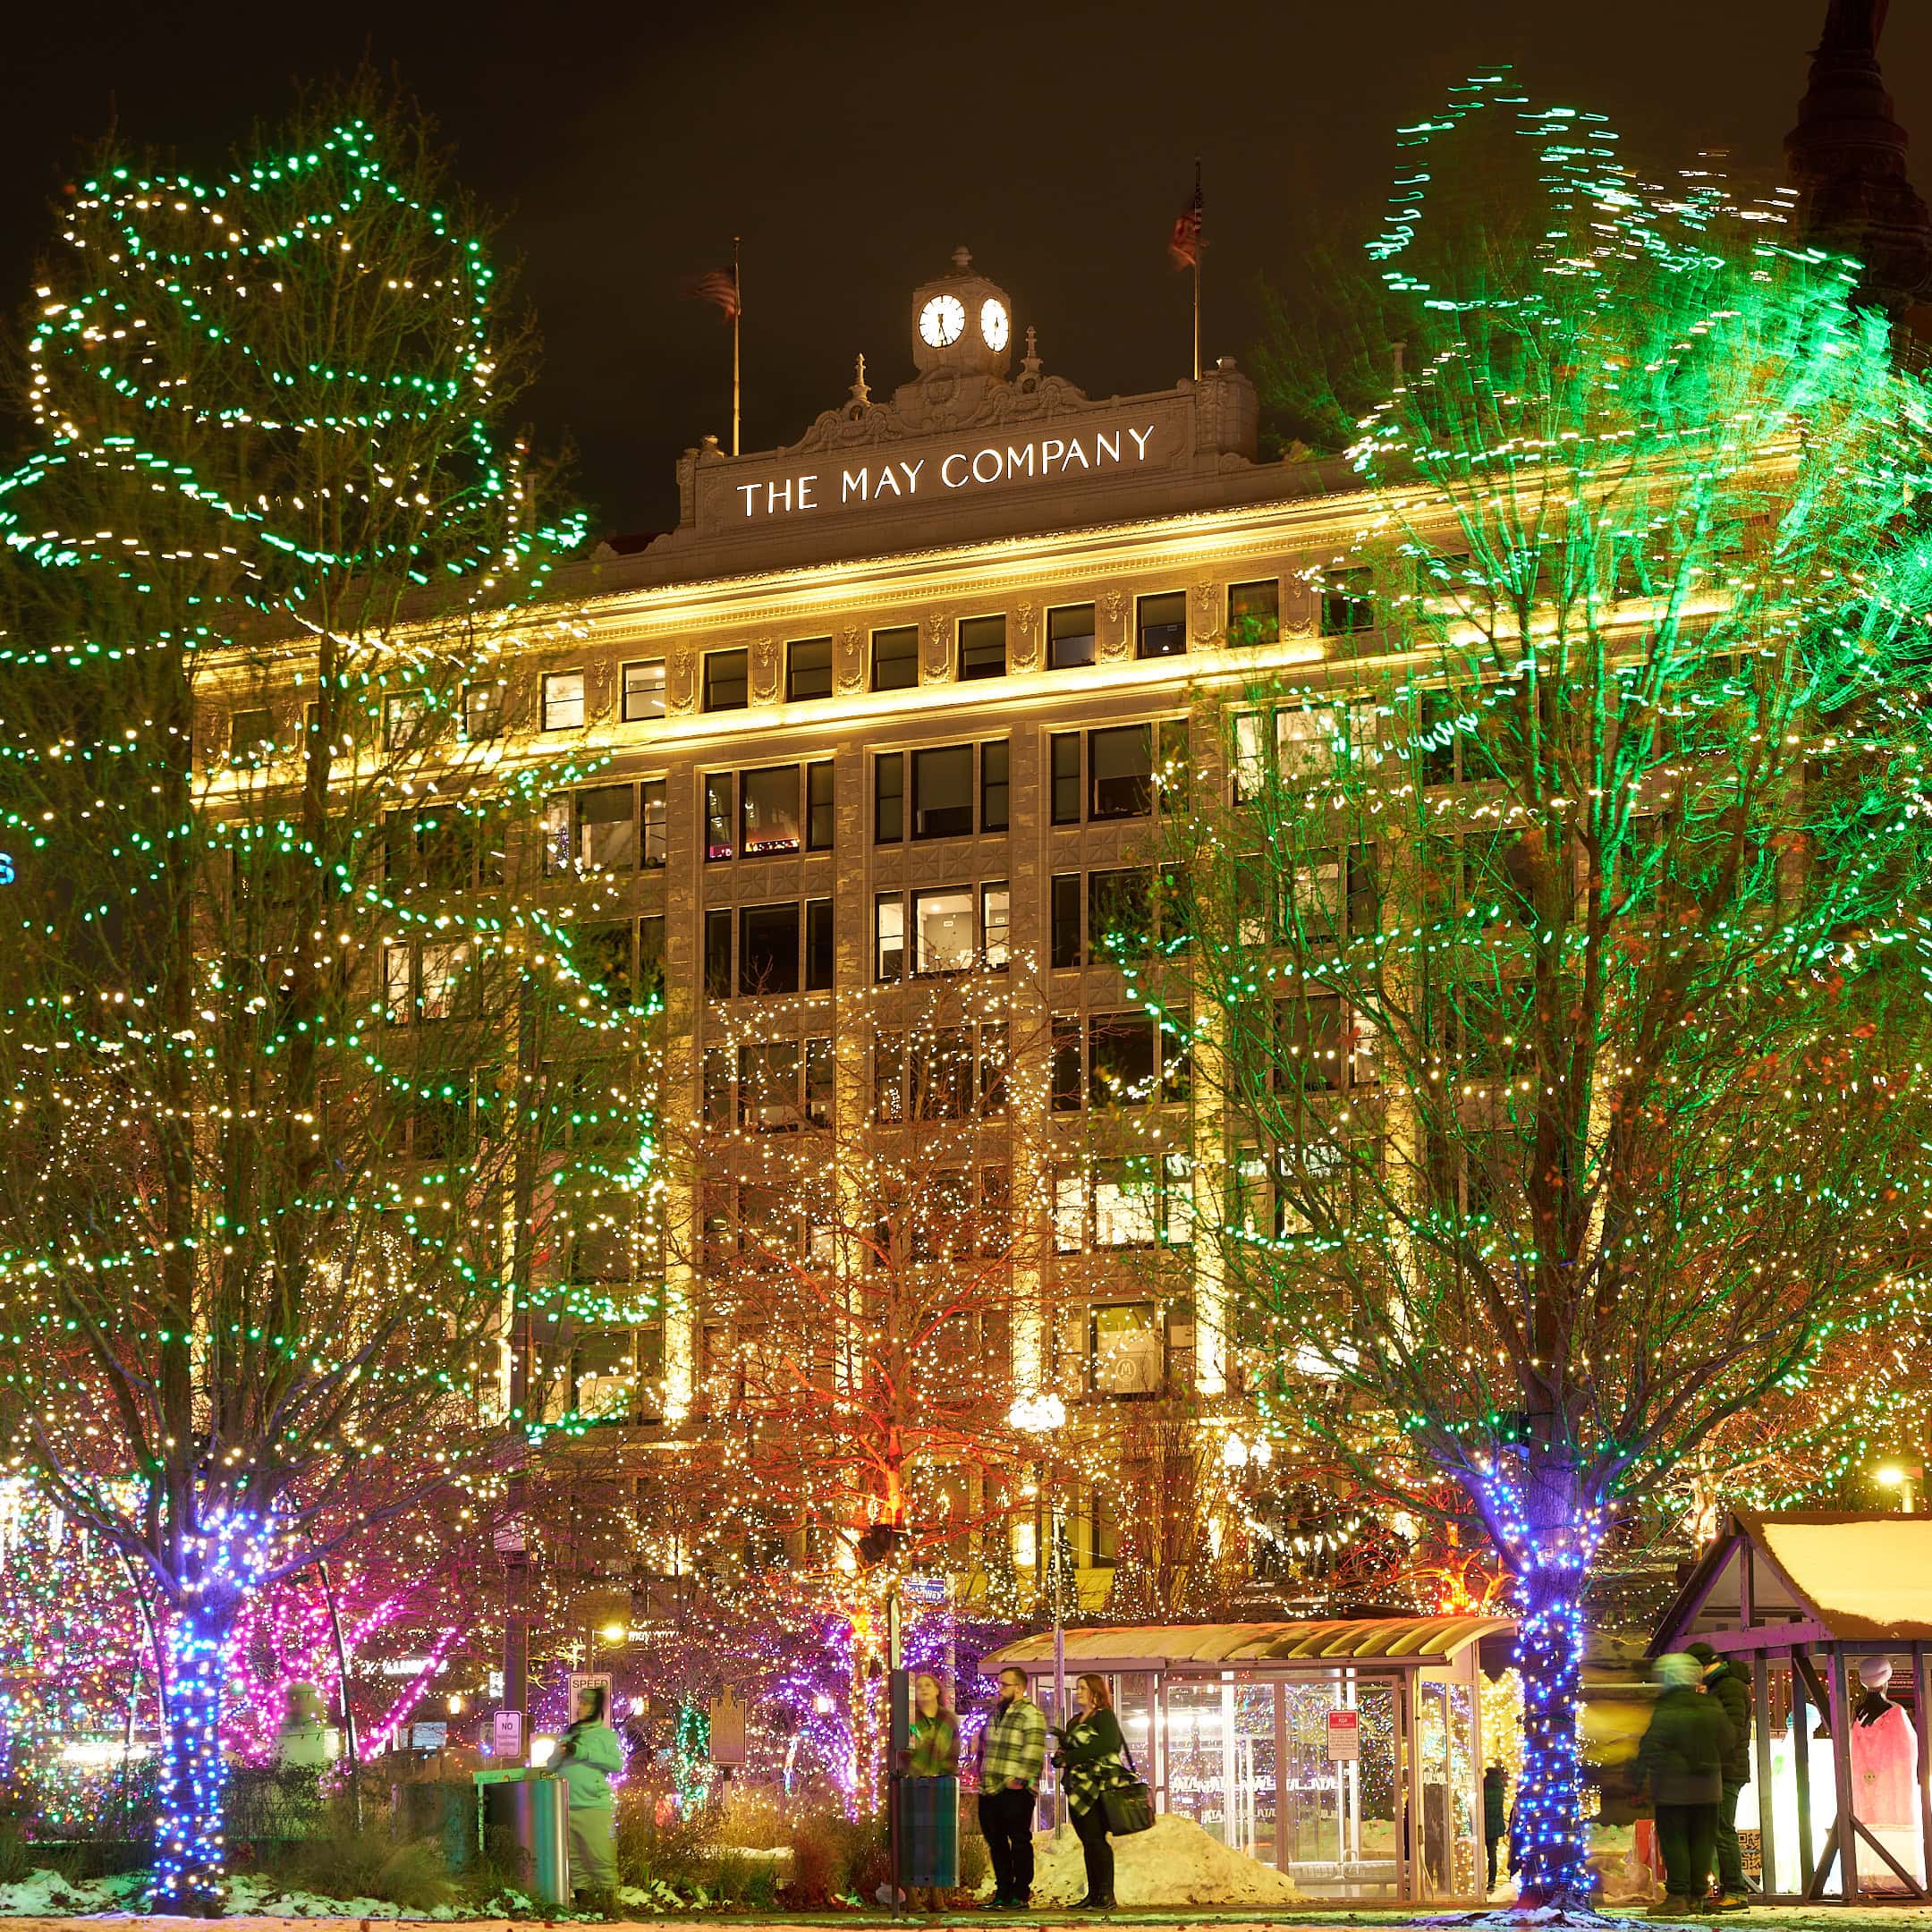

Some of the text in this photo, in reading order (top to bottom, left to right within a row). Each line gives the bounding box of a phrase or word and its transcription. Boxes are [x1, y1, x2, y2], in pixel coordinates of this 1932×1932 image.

[736, 425, 1154, 517] THE MAY COMPANY
[572, 1679, 608, 1689] SPEED
[501, 1723, 513, 1731] NO
